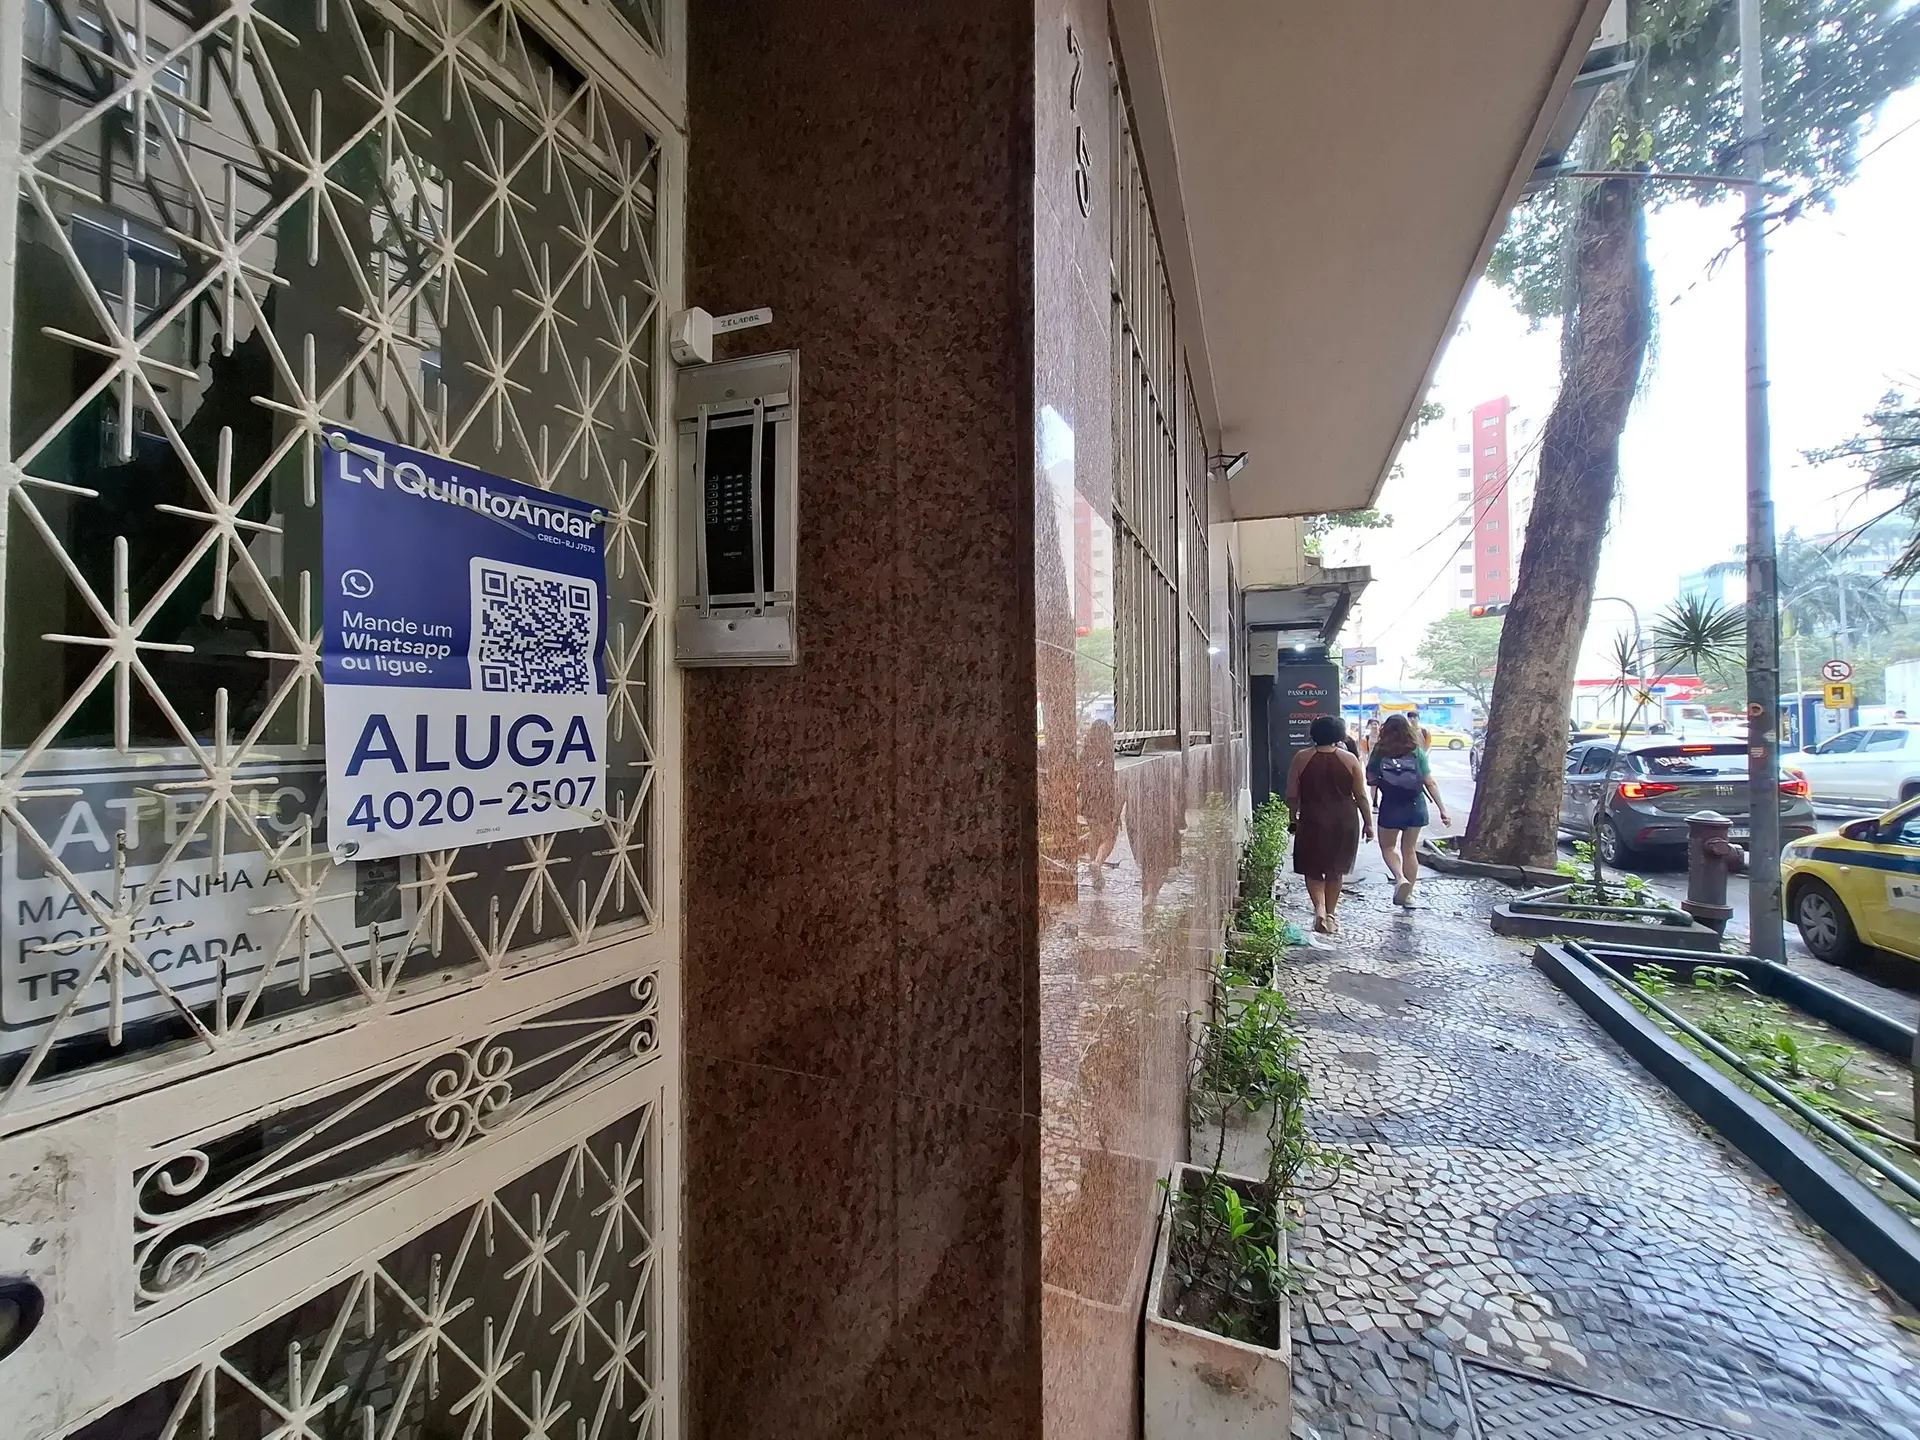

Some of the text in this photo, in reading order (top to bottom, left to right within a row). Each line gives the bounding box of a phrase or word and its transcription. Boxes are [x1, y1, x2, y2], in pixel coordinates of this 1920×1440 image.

[720, 314, 760, 328] ZELADOR
[393, 461, 596, 540] QuintoAndar
[537, 533, 596, 554] CRECI-RJ J7575
[342, 610, 453, 639] Mande um
[341, 631, 451, 660] Whatsapp
[341, 655, 434, 677] ou ligue.
[344, 713, 597, 778] ALUGA
[346, 776, 597, 834] 4020-2507
